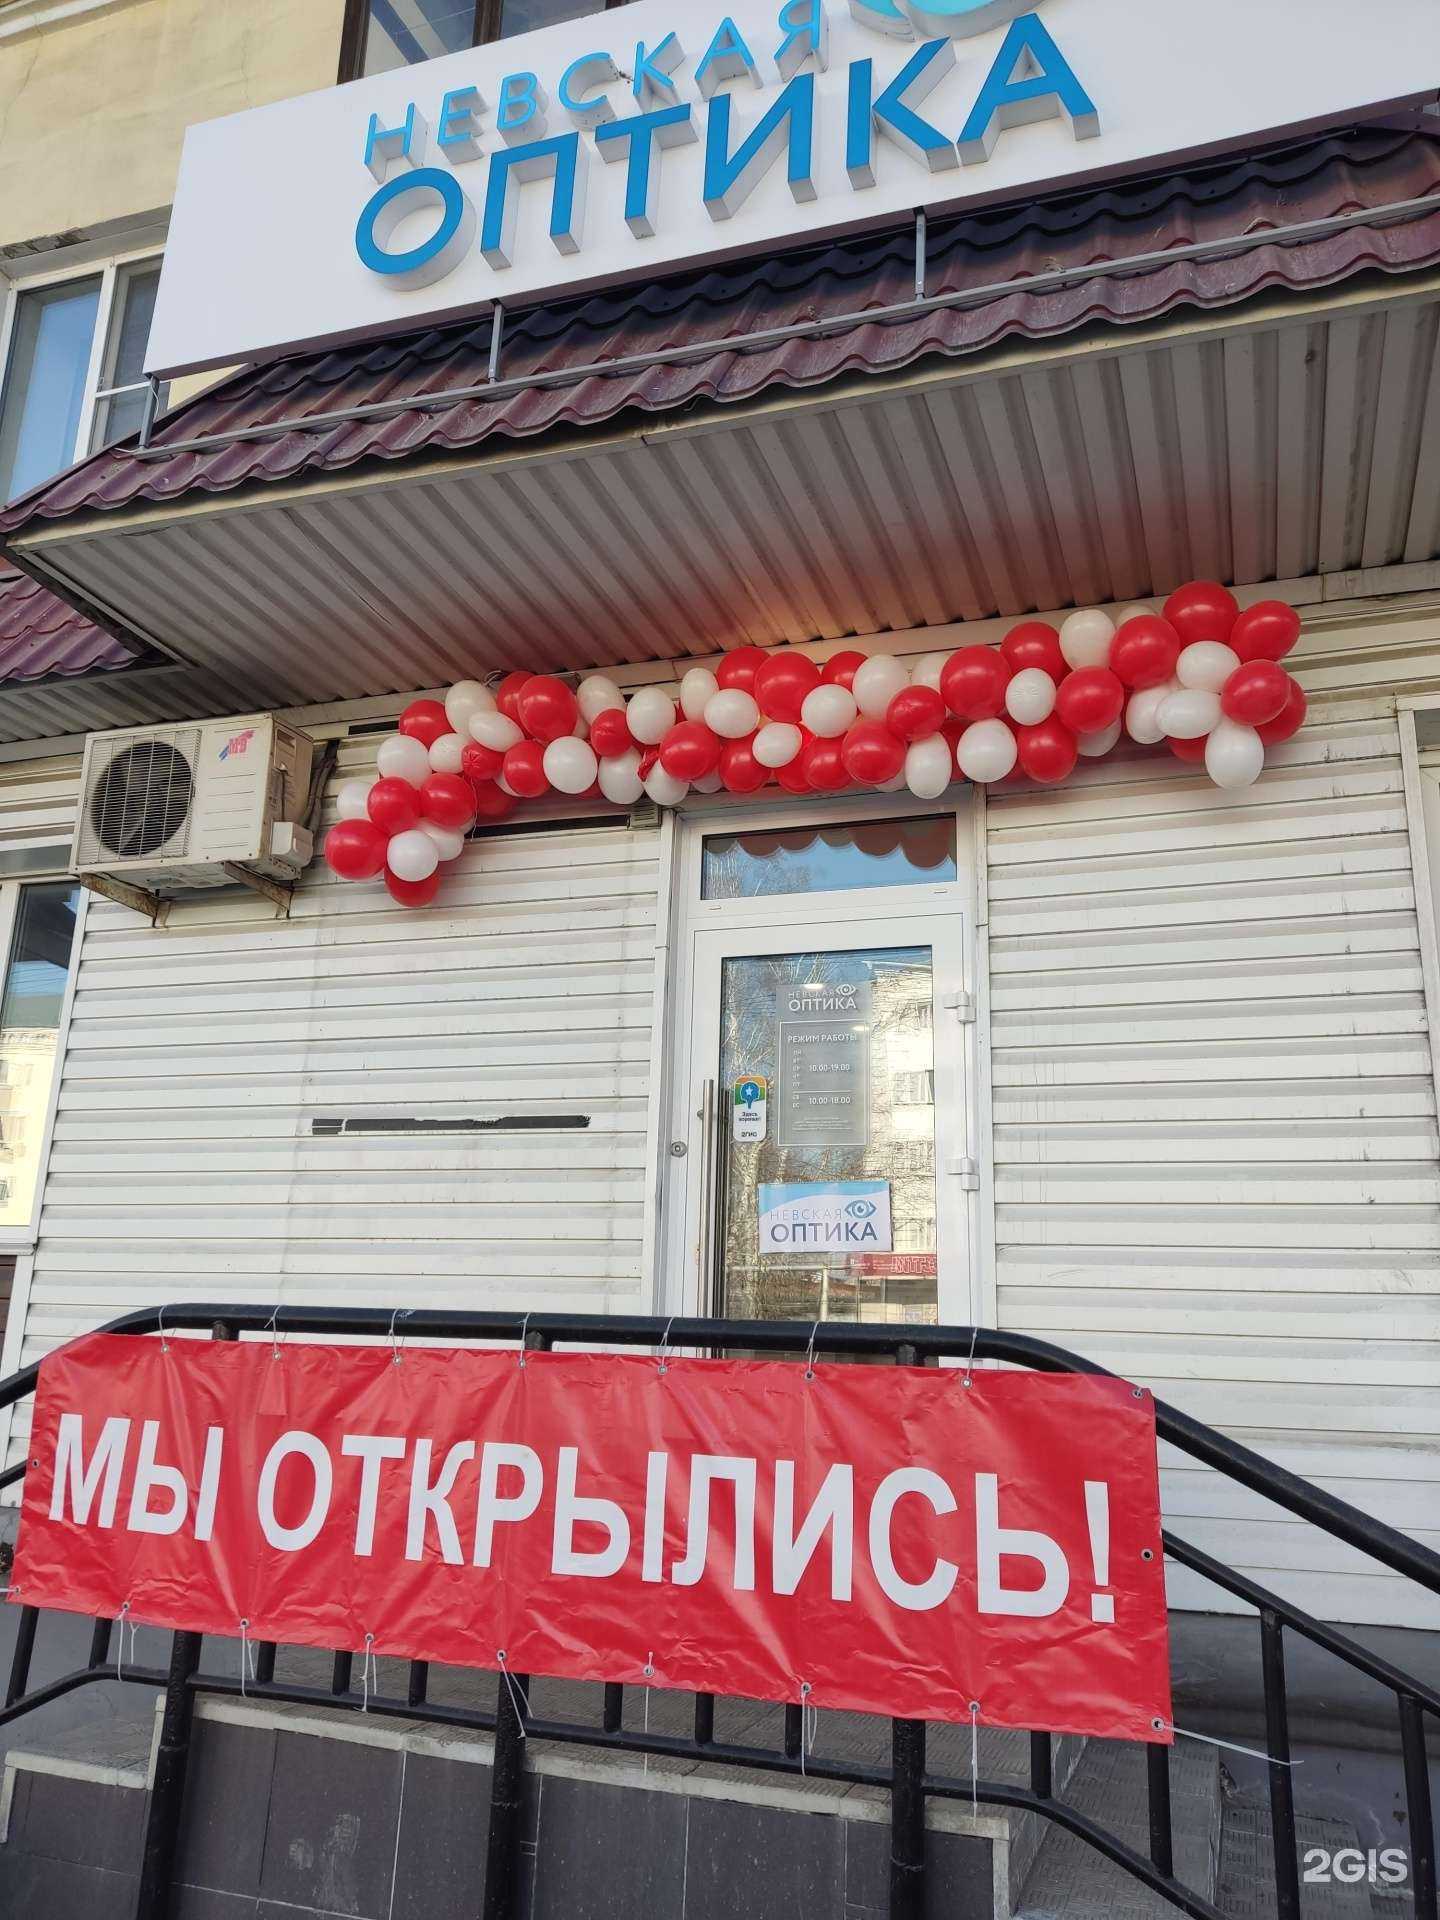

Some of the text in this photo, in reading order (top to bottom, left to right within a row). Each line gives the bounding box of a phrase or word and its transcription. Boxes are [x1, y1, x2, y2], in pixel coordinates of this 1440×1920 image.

[364, 0, 823, 174] НЕВСКАЯ
[356, 13, 1098, 280] ОПТИКА
[788, 997, 857, 1012] ОПТИКА
[787, 1033, 857, 1043] РЕЖИМ РАБОТЫ
[770, 1208, 842, 1221] НЕВСКАЯ
[770, 1222, 878, 1243] ОПТИКА
[48, 1413, 1115, 1623] МЫ ОТКРЫЛИСЬ!
